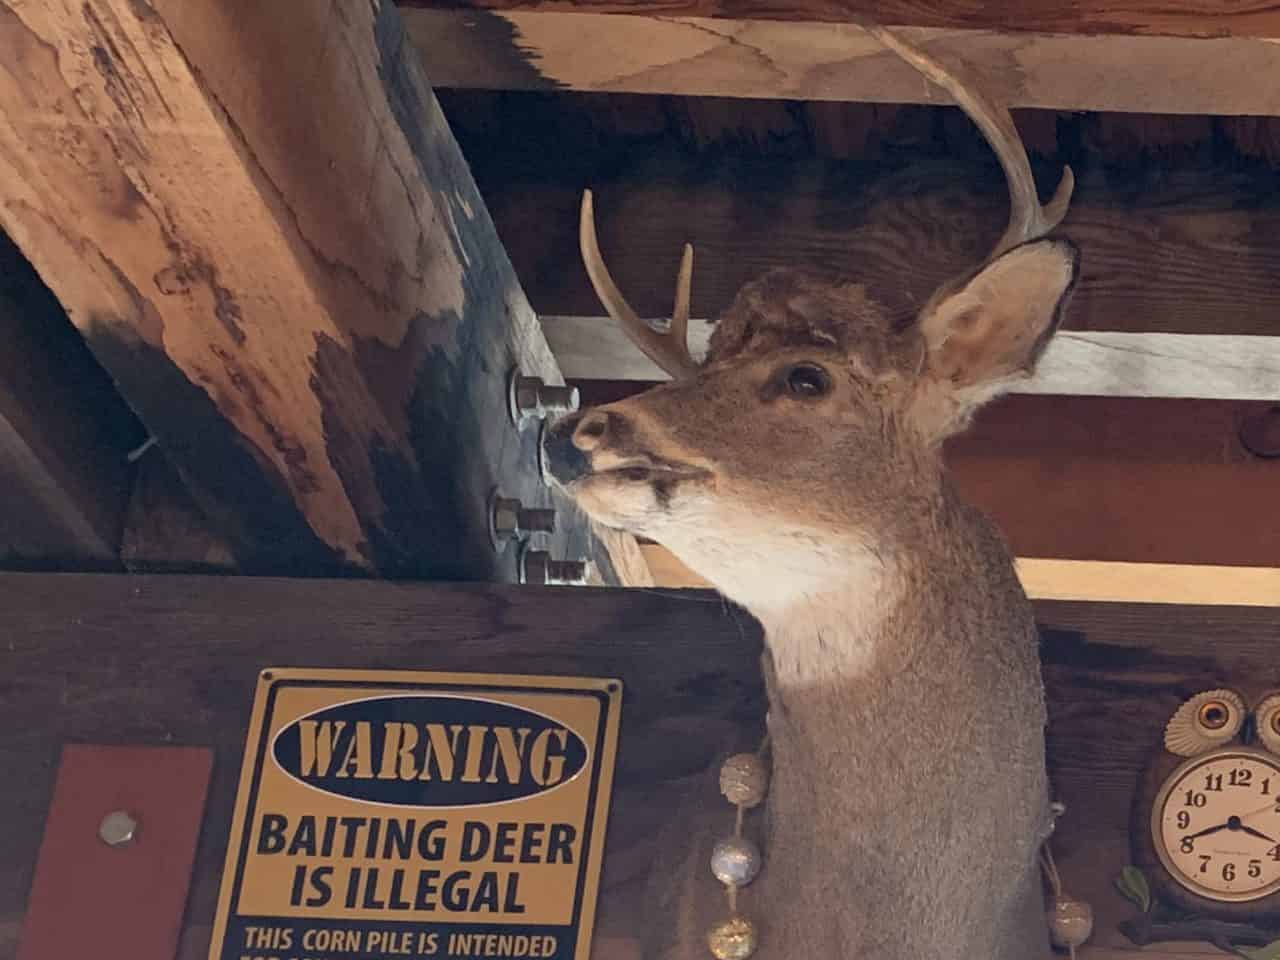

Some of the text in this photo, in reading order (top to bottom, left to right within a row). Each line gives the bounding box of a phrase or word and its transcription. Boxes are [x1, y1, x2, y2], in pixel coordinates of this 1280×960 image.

[298, 719, 569, 787] WARNING
[1204, 773, 1223, 791] 11
[1227, 768, 1252, 787] 12
[1261, 777, 1270, 795] 1
[1184, 790, 1207, 807] 10
[1177, 810, 1190, 829] 9
[256, 814, 577, 865] BAITING DEER
[1180, 835, 1194, 854] 8
[1198, 855, 1211, 872] 7
[1222, 863, 1236, 881] 6
[1248, 859, 1262, 878] 5
[290, 865, 526, 914] IS ILLEGAL
[245, 928, 557, 958] THIS CORN PILE IS INTENDED
